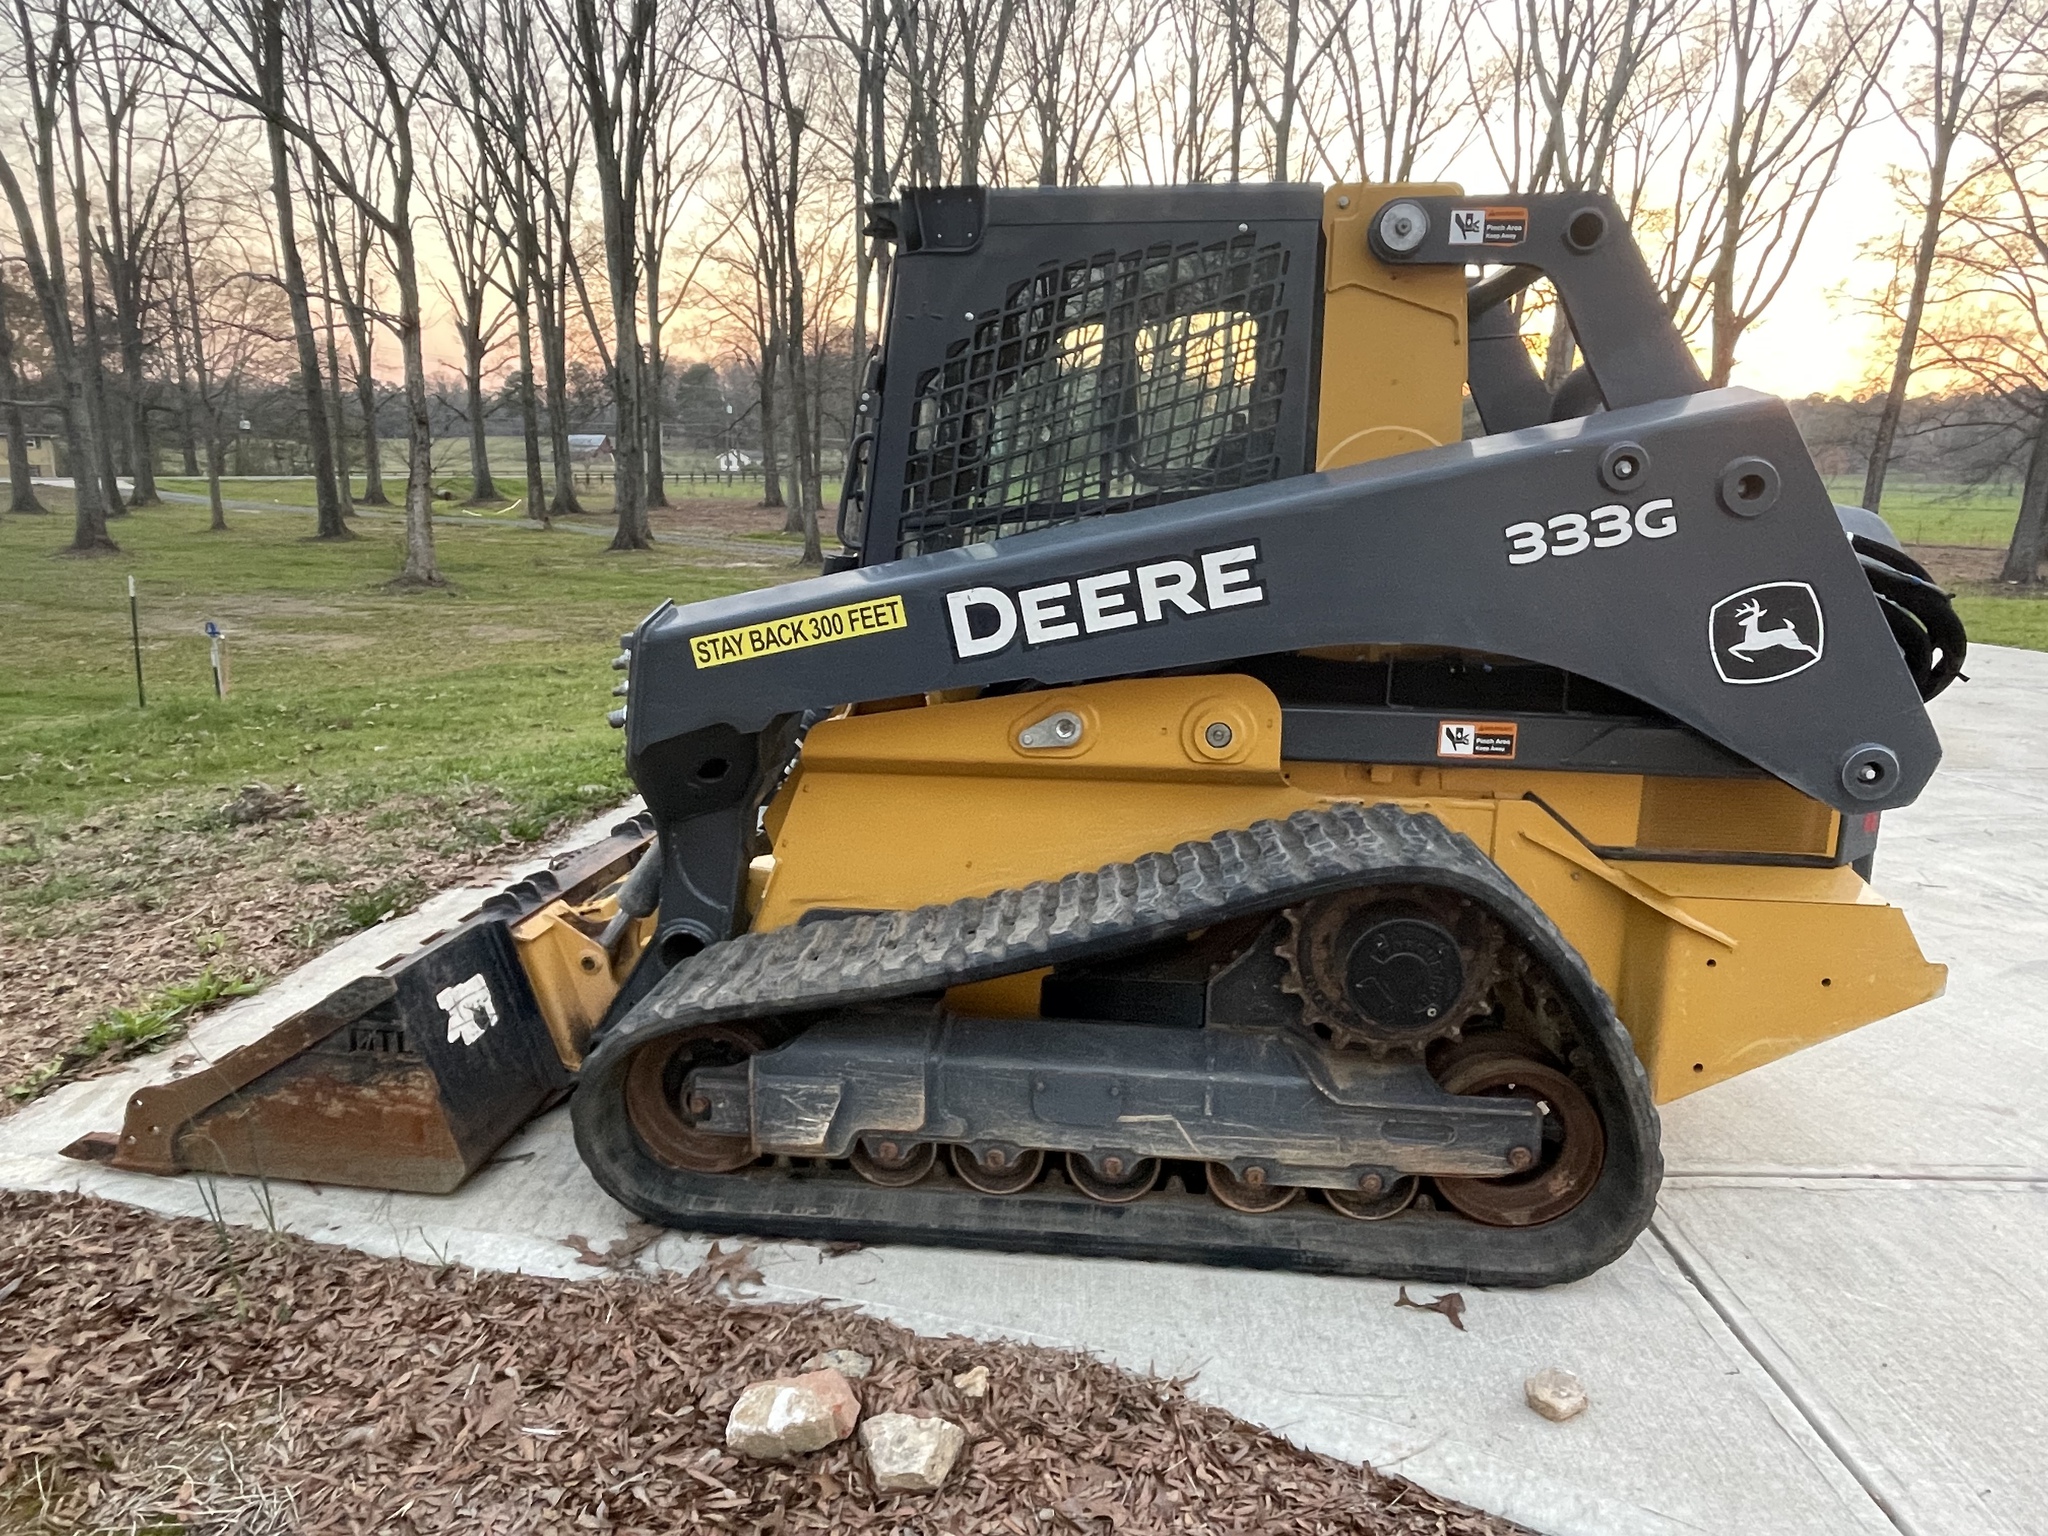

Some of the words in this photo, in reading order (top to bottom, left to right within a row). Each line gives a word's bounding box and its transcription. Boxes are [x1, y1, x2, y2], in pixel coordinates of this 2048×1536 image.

[1501, 232, 1516, 240] Away
[1505, 498, 1677, 565] 333G
[696, 633, 743, 663] STAY
[749, 620, 808, 653] BACK
[808, 612, 843, 640] 300
[847, 601, 899, 632] FEET
[946, 545, 1264, 658] DEERE
